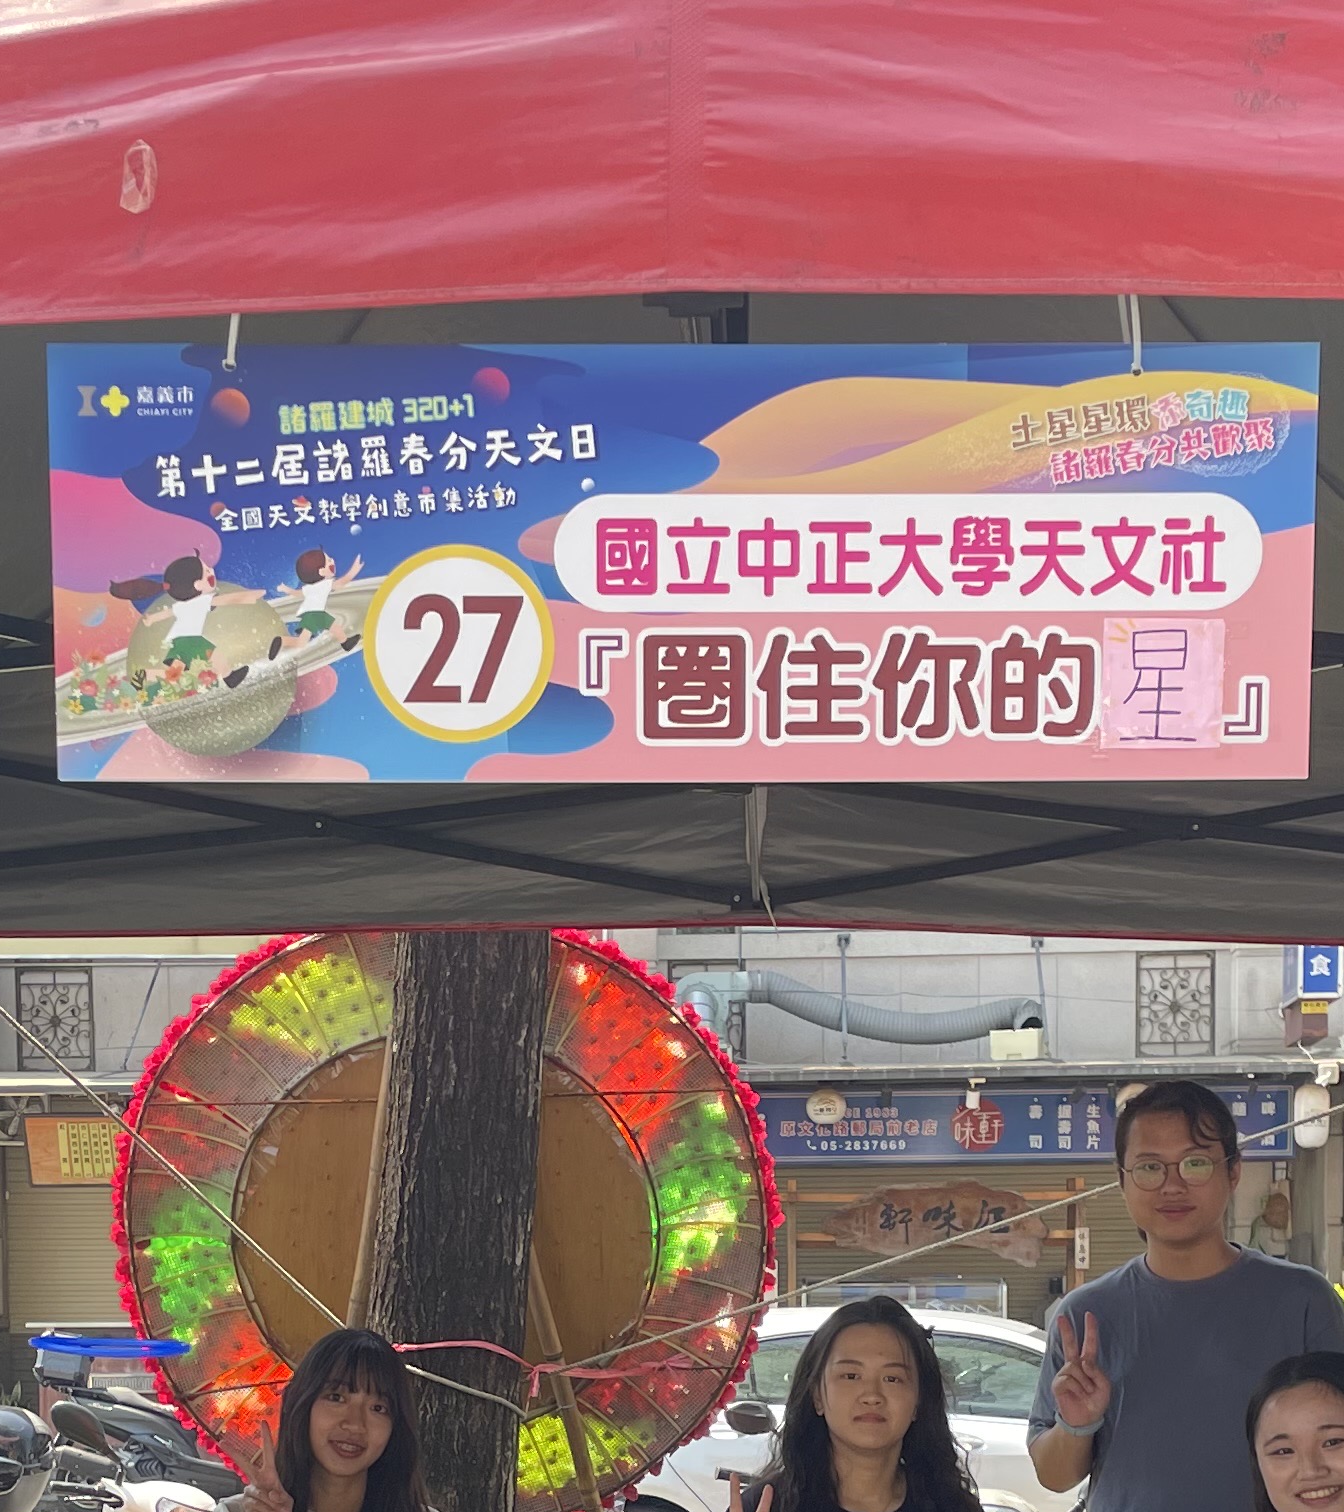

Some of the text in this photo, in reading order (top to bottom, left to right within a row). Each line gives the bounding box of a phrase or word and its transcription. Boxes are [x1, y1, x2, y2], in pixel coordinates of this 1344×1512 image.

[136, 385, 195, 405] 嘉義市
[136, 407, 194, 417] CHIAYI CITY
[278, 394, 476, 435] 諸羅建城 320+1
[1011, 387, 1250, 450] 土星星環添奇趣
[155, 423, 598, 499] 第十二屆諸羅春分天文日
[1049, 418, 1276, 486] 諸羅春分共歡聚
[214, 486, 518, 533] 全國天文教學創意市集活動
[595, 515, 1227, 597] 國立中正大學天文社
[403, 594, 524, 704] 27
[779, 1120, 939, 1137] 原文化路郵局前老店
[820, 1139, 907, 1151] 05-2837669
[1028, 1105, 1043, 1150] 壽司
[1086, 1104, 1101, 1150] 生魚片
